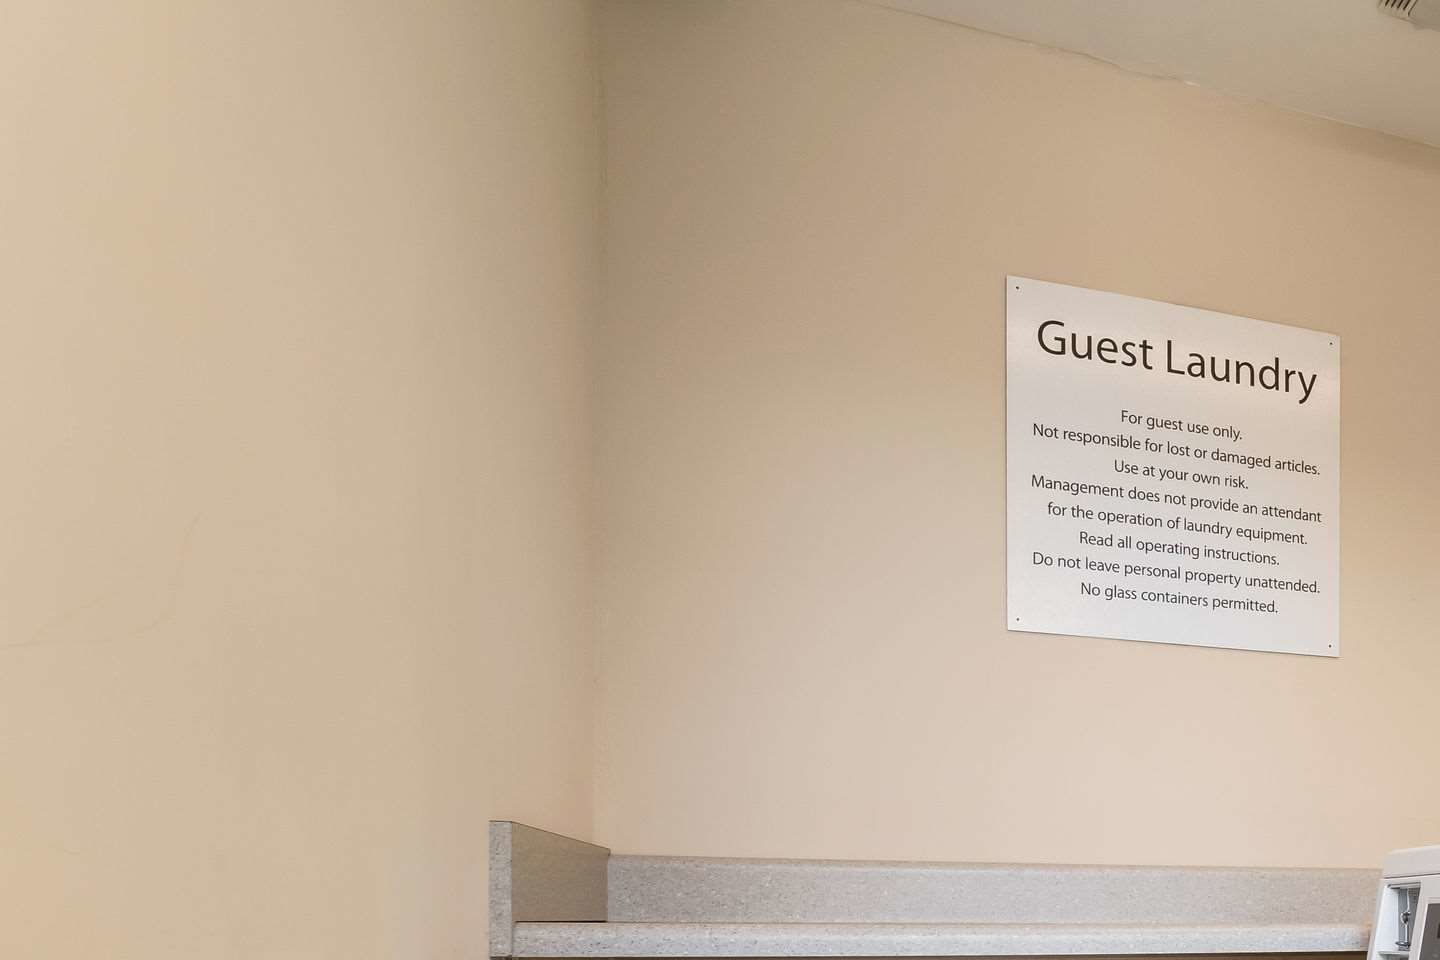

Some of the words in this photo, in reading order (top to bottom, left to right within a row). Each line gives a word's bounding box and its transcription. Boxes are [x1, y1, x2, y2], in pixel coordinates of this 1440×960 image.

[1037, 319, 1154, 371] Guest
[1166, 339, 1318, 405] Laundry
[1121, 409, 1143, 425] For
[1146, 416, 1184, 432] guest
[1187, 423, 1210, 436] use
[1212, 425, 1243, 443] only.
[1033, 422, 1059, 440] Not
[1063, 430, 1141, 450] responsible
[1144, 437, 1164, 453] for
[1167, 440, 1191, 457] lost
[1193, 448, 1208, 459] or
[1210, 447, 1272, 470] damaged
[1274, 459, 1321, 476] articles.
[1114, 459, 1139, 475] Use
[1142, 465, 1156, 478] at
[1158, 468, 1189, 482] your
[1192, 473, 1221, 486] own
[1224, 474, 1249, 490] risk.
[1031, 474, 1125, 498] Management
[1127, 486, 1161, 503] does
[1164, 494, 1187, 506] not
[1190, 497, 1240, 513] provide
[1242, 503, 1258, 515] an
[1261, 505, 1323, 523] attendant
[1047, 501, 1068, 517] for
[1070, 504, 1094, 520] the
[1097, 511, 1163, 528] operation
[1166, 516, 1182, 530] of
[1183, 517, 1233, 539] laundry
[1235, 527, 1308, 545] equipment.
[1079, 530, 1113, 547] Read
[1117, 535, 1132, 550] all
[1135, 540, 1200, 560] operating
[1203, 544, 1280, 566] instructions.
[1032, 551, 1054, 567] Do
[1057, 557, 1082, 570] not
[1085, 556, 1121, 574] leave
[1124, 564, 1181, 580] personal
[1185, 570, 1242, 589] property
[1245, 577, 1321, 594] unattended.
[1081, 581, 1101, 597] No
[1104, 584, 1138, 601] glass
[1140, 591, 1209, 607] containers
[1212, 598, 1279, 614] permitted.
